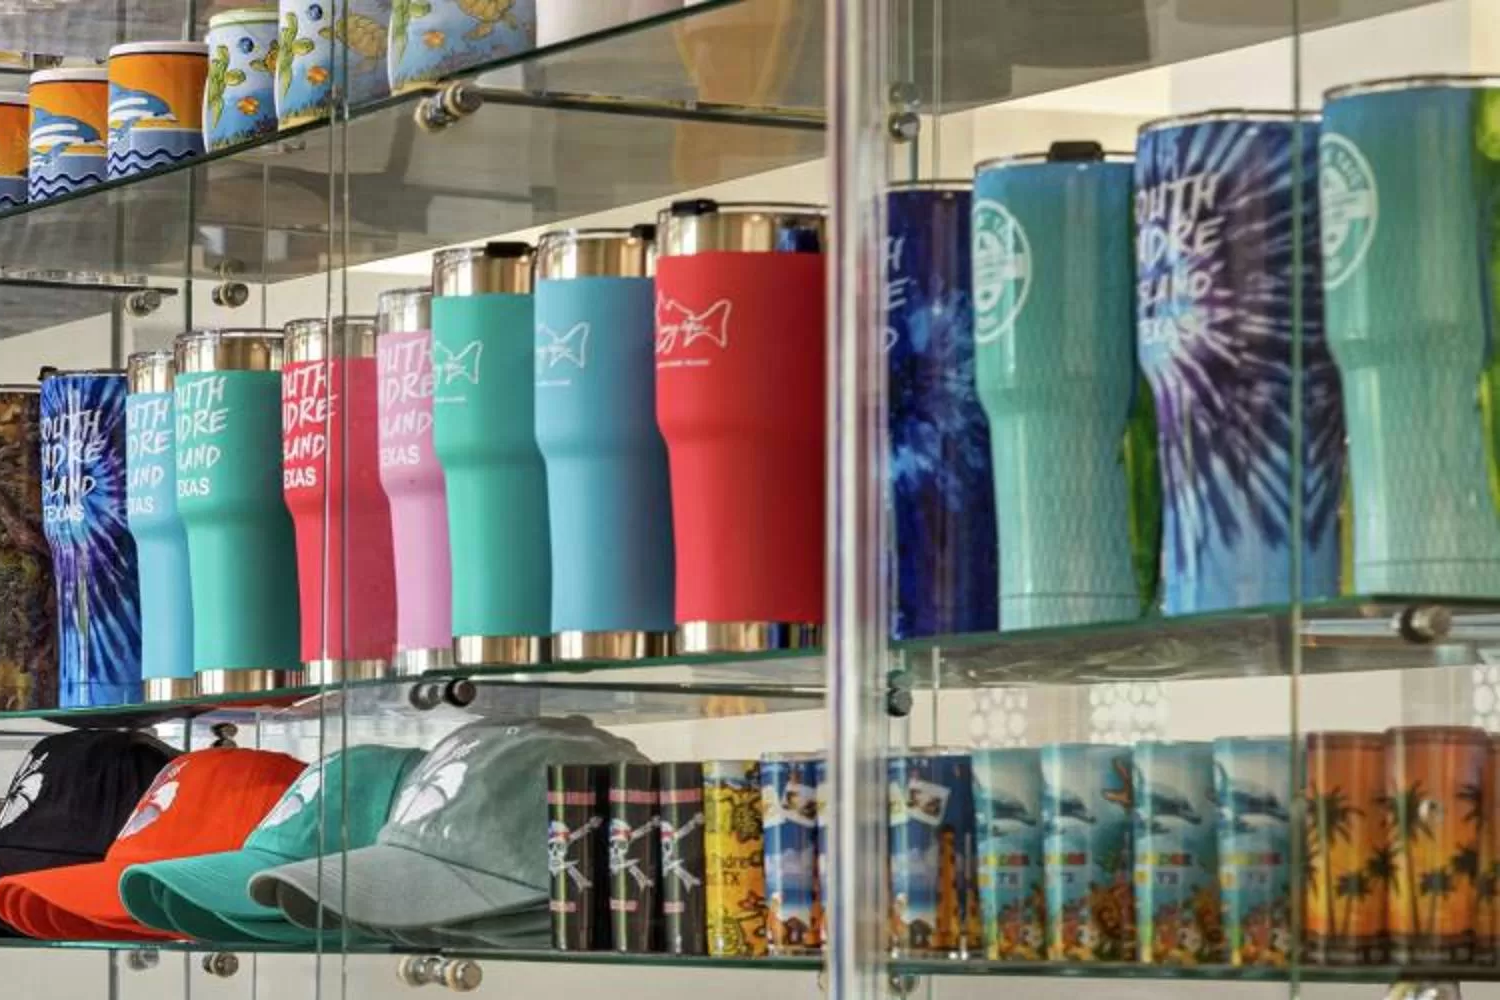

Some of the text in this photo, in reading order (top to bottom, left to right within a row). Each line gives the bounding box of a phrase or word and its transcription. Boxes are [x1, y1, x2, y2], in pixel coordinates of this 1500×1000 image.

[1135, 170, 1222, 225] OUTH
[41, 407, 103, 443] OUTH
[283, 433, 326, 464] LAND
[380, 443, 421, 467] EXAS
[177, 476, 211, 497] EXAS
[283, 465, 317, 489] EXAS
